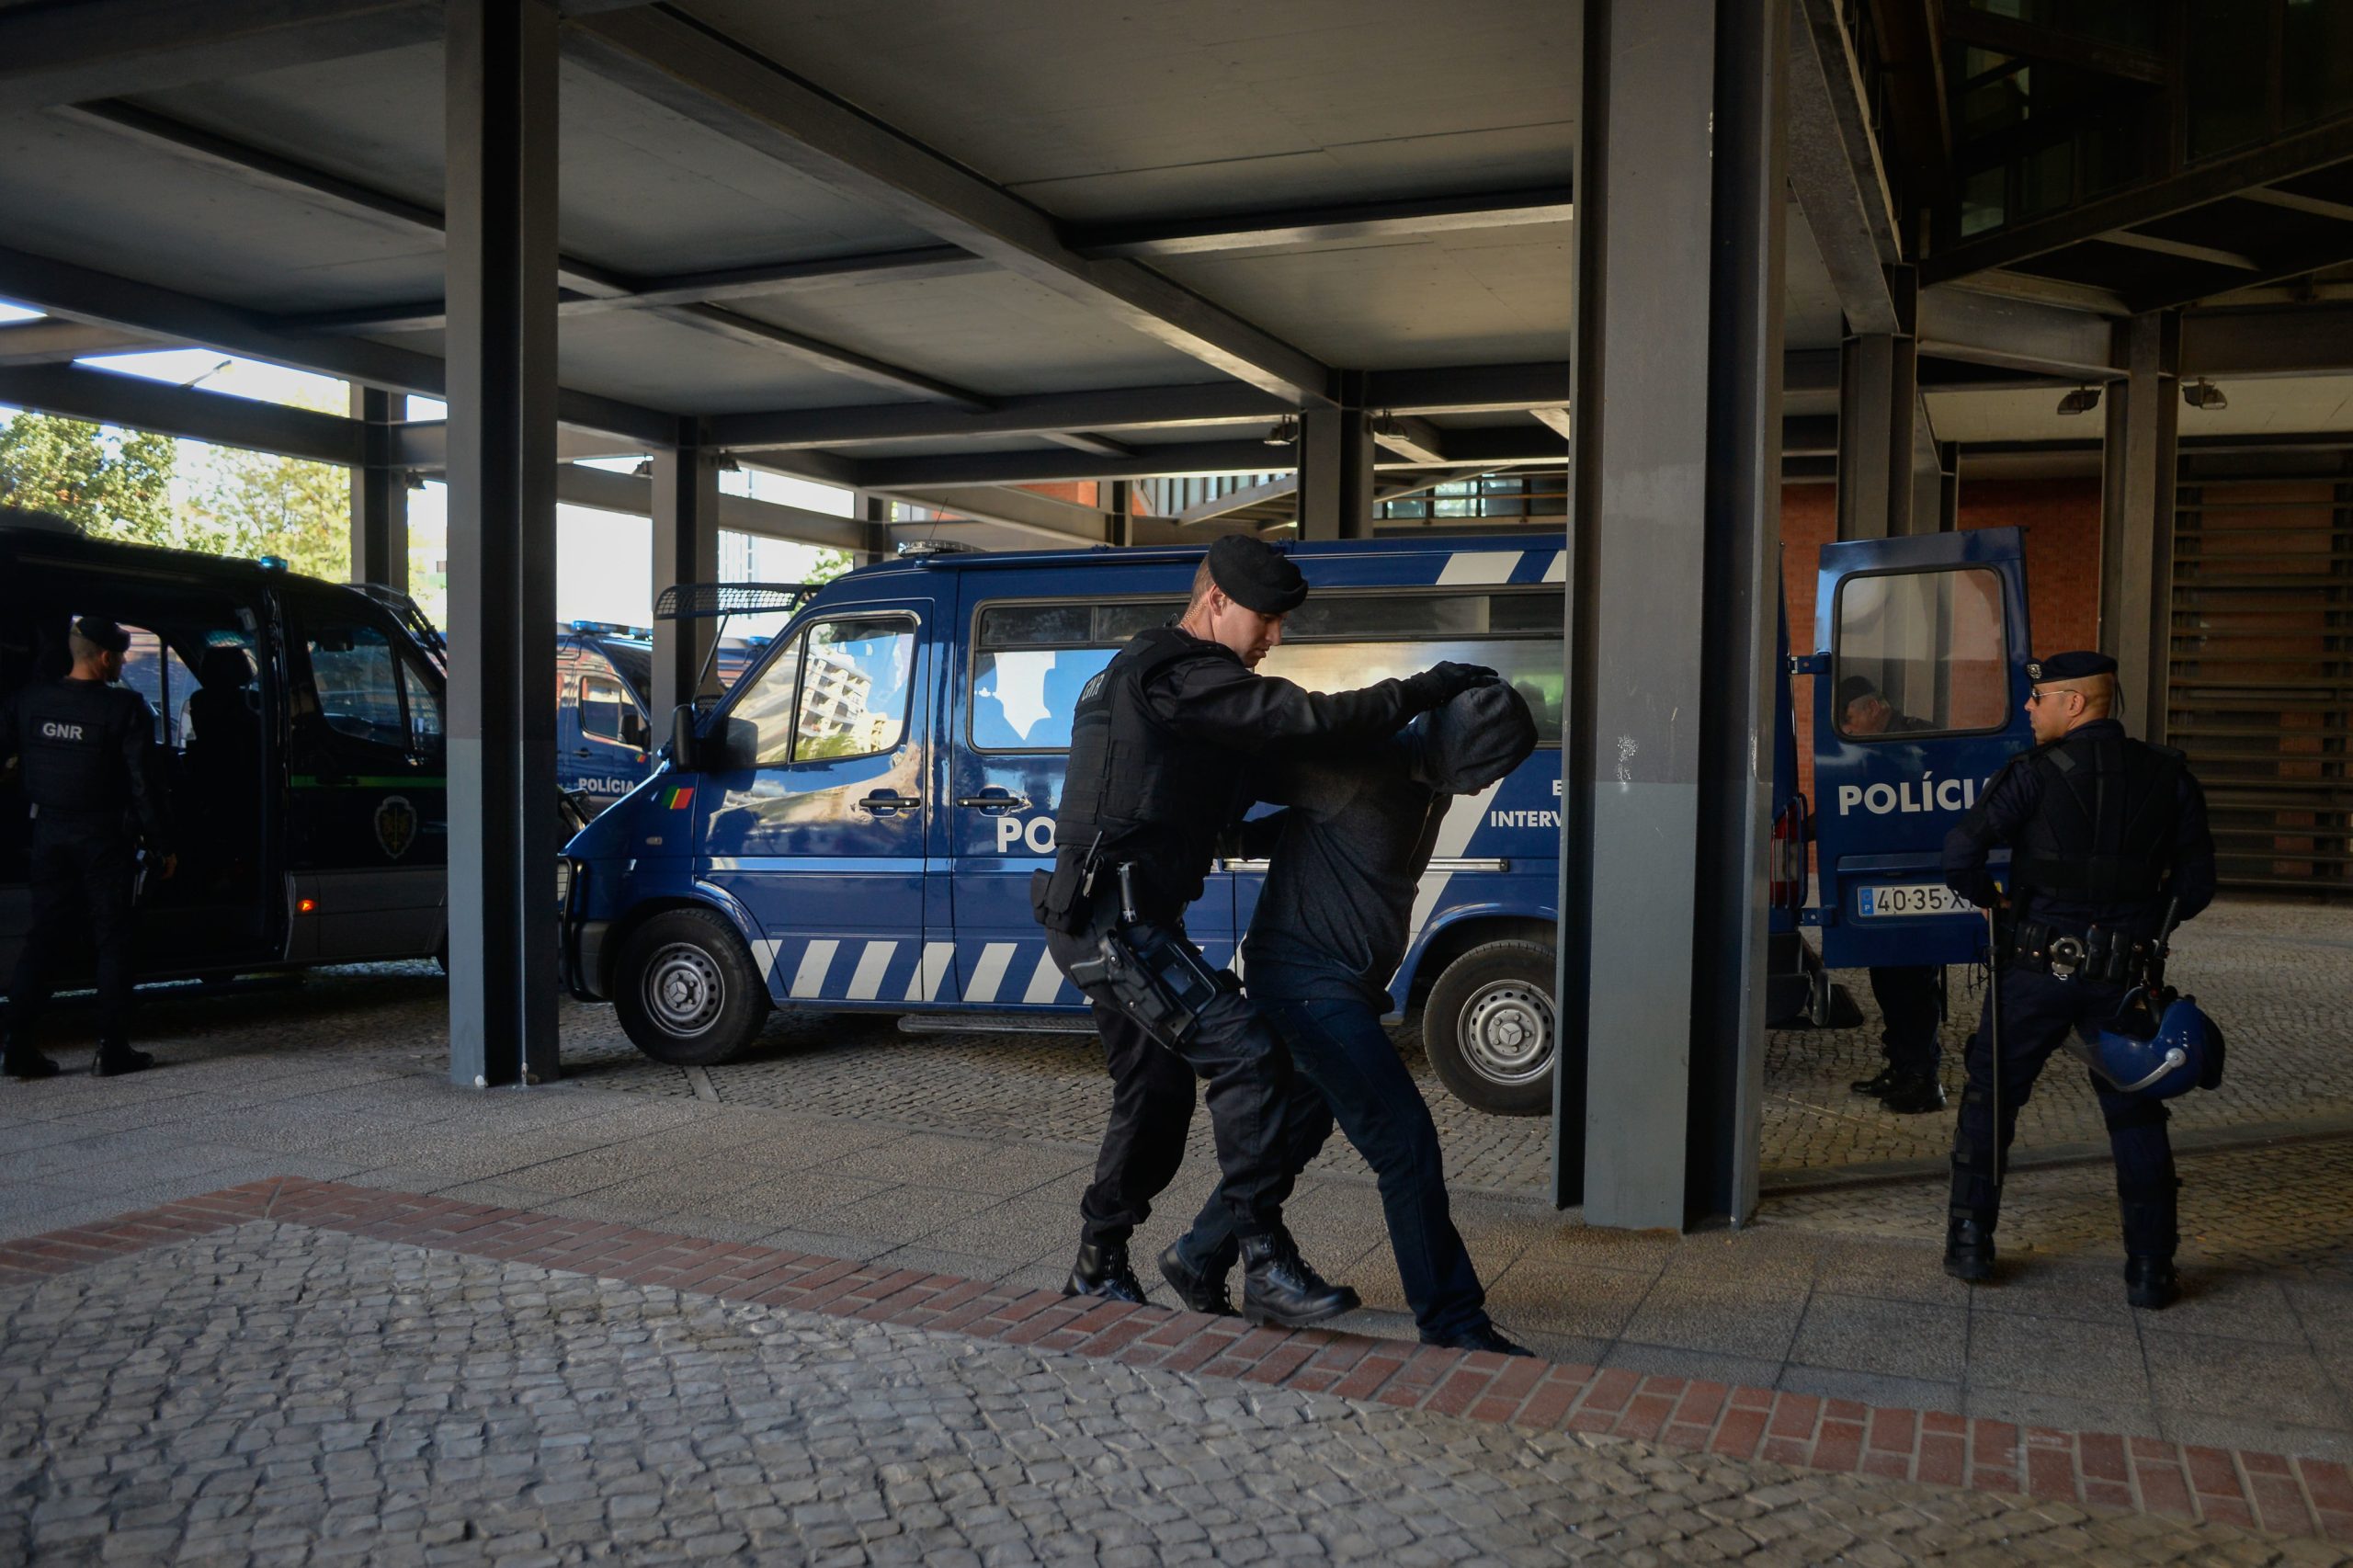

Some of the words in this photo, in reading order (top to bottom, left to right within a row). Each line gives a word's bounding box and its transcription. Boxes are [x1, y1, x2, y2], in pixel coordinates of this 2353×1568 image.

[1082, 674, 1105, 701] GNR
[43, 722, 83, 740] GNR
[578, 777, 634, 793] POLÍCIA
[1838, 771, 1991, 815] POLÍCI
